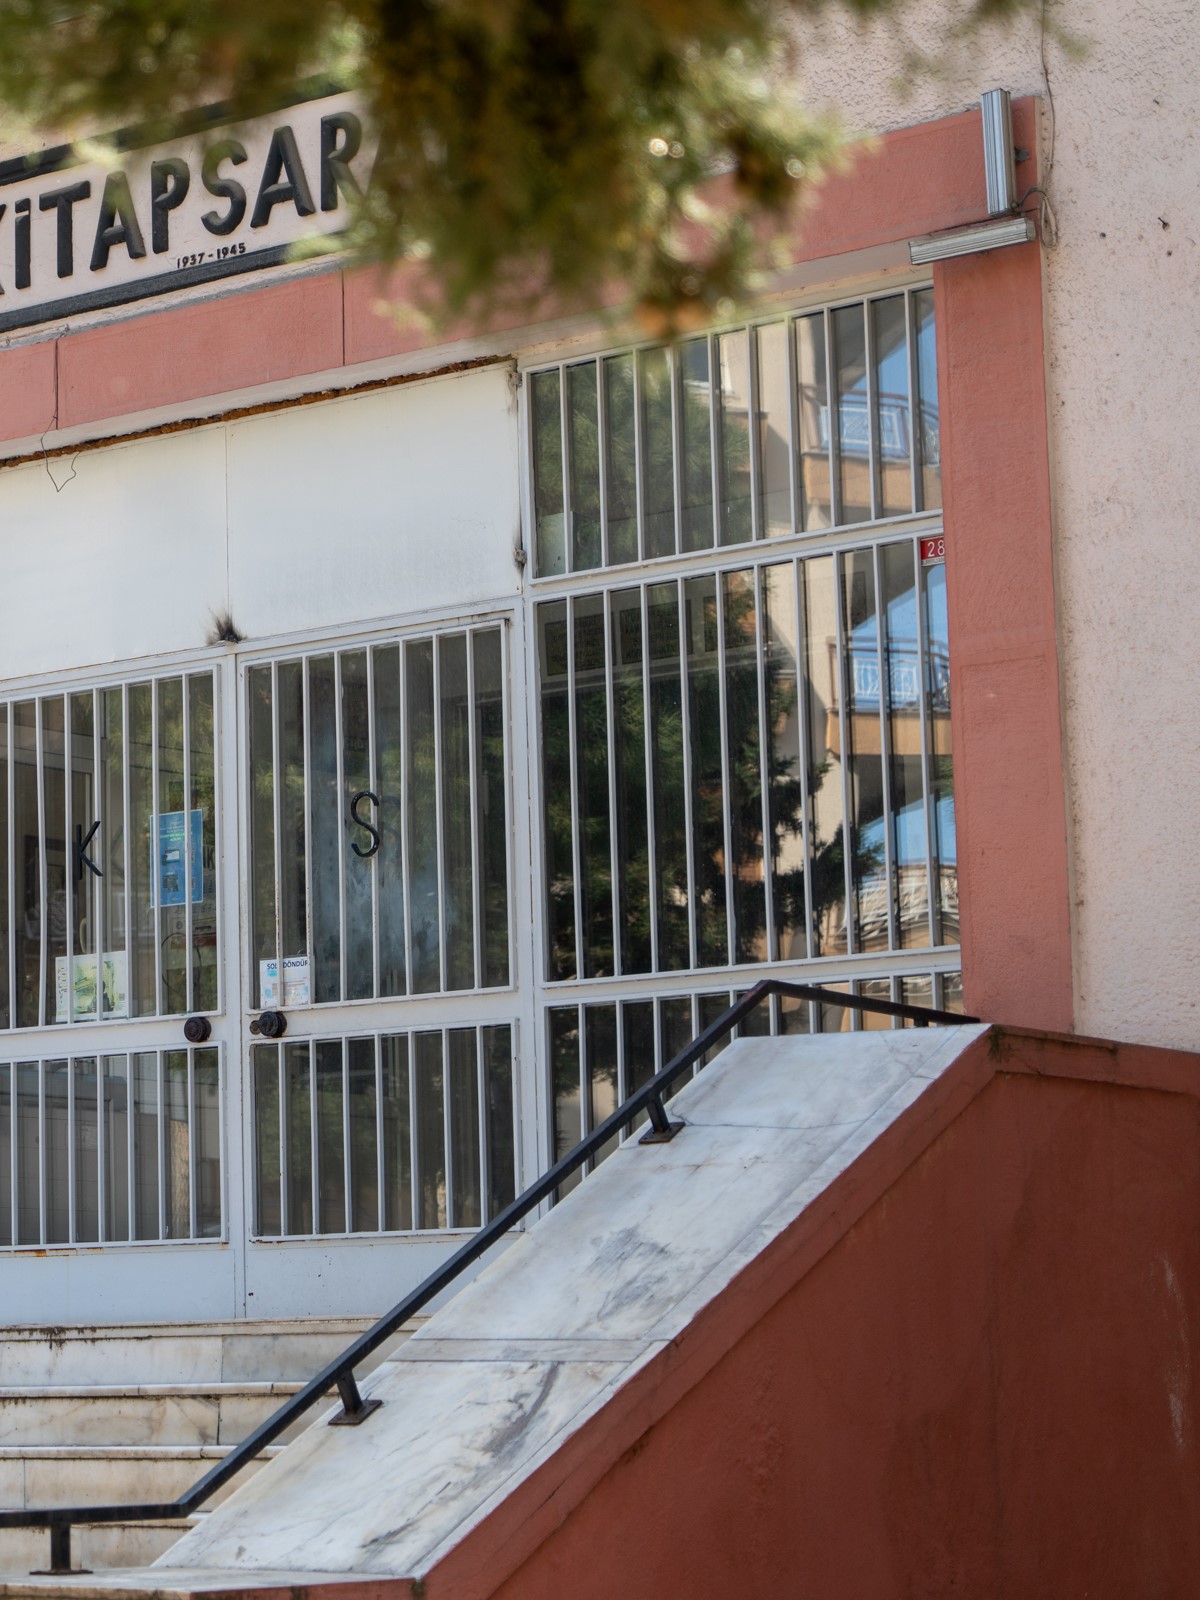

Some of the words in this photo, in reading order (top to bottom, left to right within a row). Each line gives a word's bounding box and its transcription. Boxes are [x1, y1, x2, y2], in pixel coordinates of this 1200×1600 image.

[927, 540, 945, 557] 28
[77, 820, 103, 880] K
[350, 790, 380, 857] S
